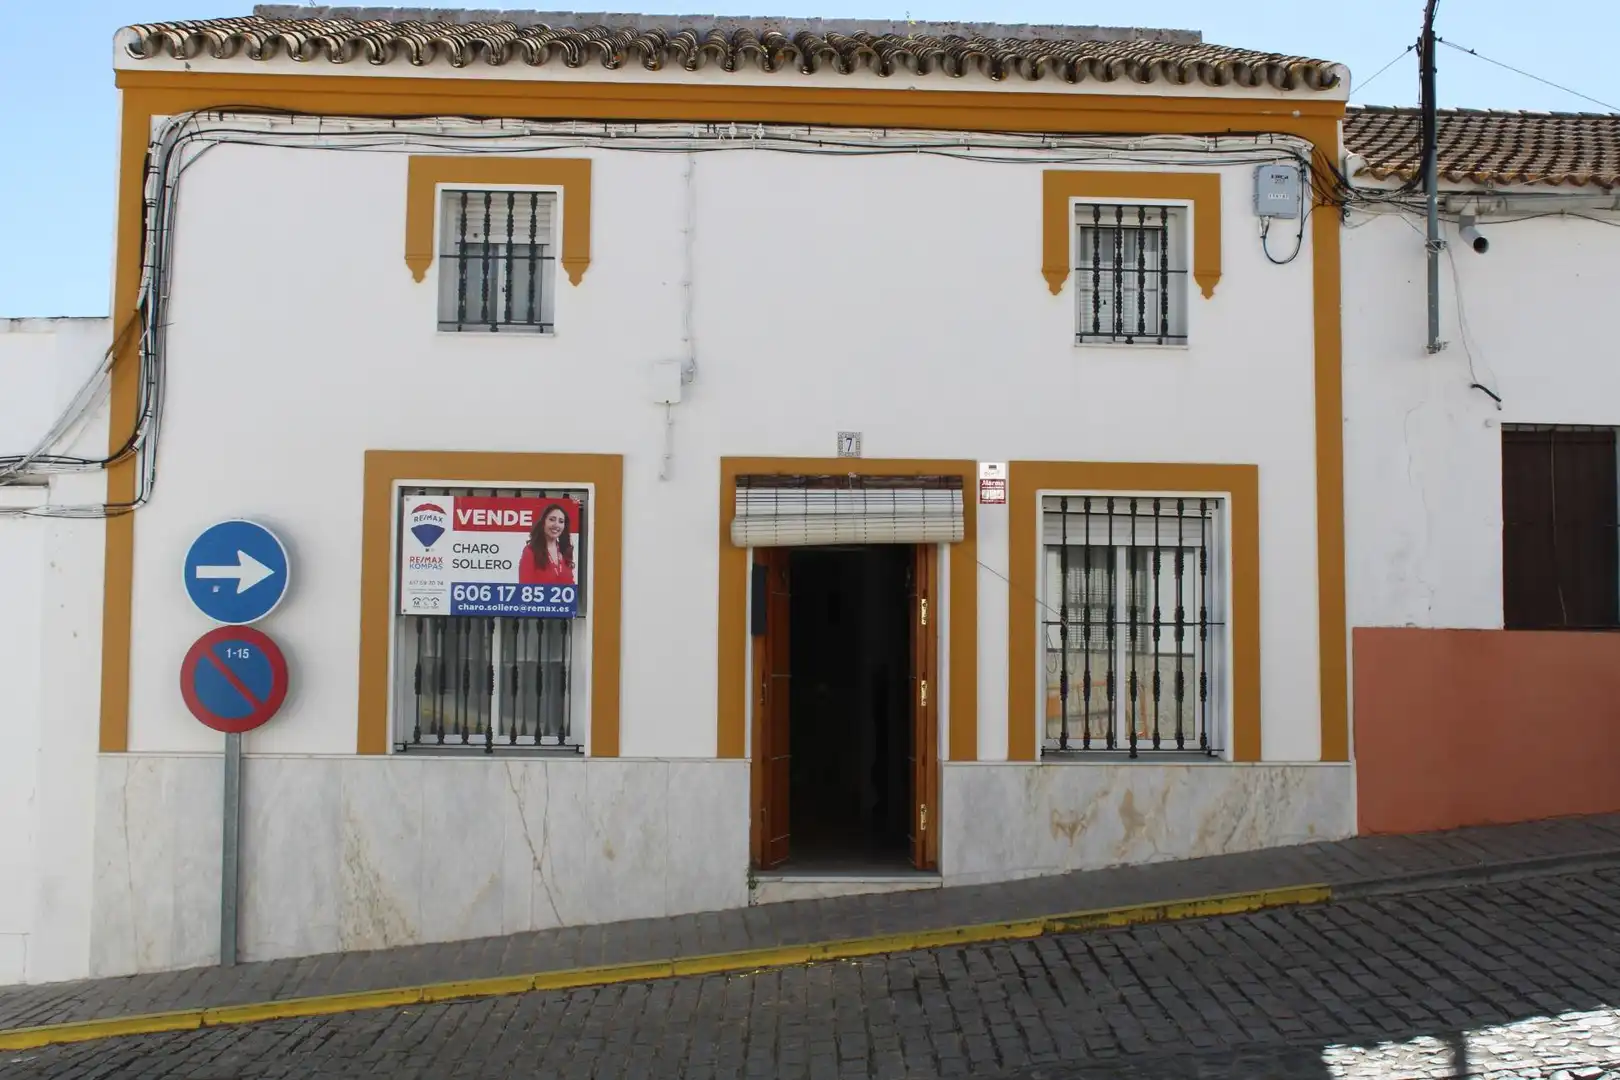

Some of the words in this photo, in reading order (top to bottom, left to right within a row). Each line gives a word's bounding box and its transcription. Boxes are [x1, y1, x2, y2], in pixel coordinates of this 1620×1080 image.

[846, 438, 853, 452] 7
[414, 515, 443, 523] RE/MAX
[456, 509, 532, 526] VENDE
[453, 543, 499, 554] CHARO
[452, 559, 512, 570] SOLLERO
[453, 585, 491, 601] 606
[497, 586, 515, 601] 17
[522, 587, 544, 602] 85
[550, 587, 574, 603] 20
[458, 604, 569, 613] charo.sollero@remax.es
[226, 648, 249, 658] 1-15
